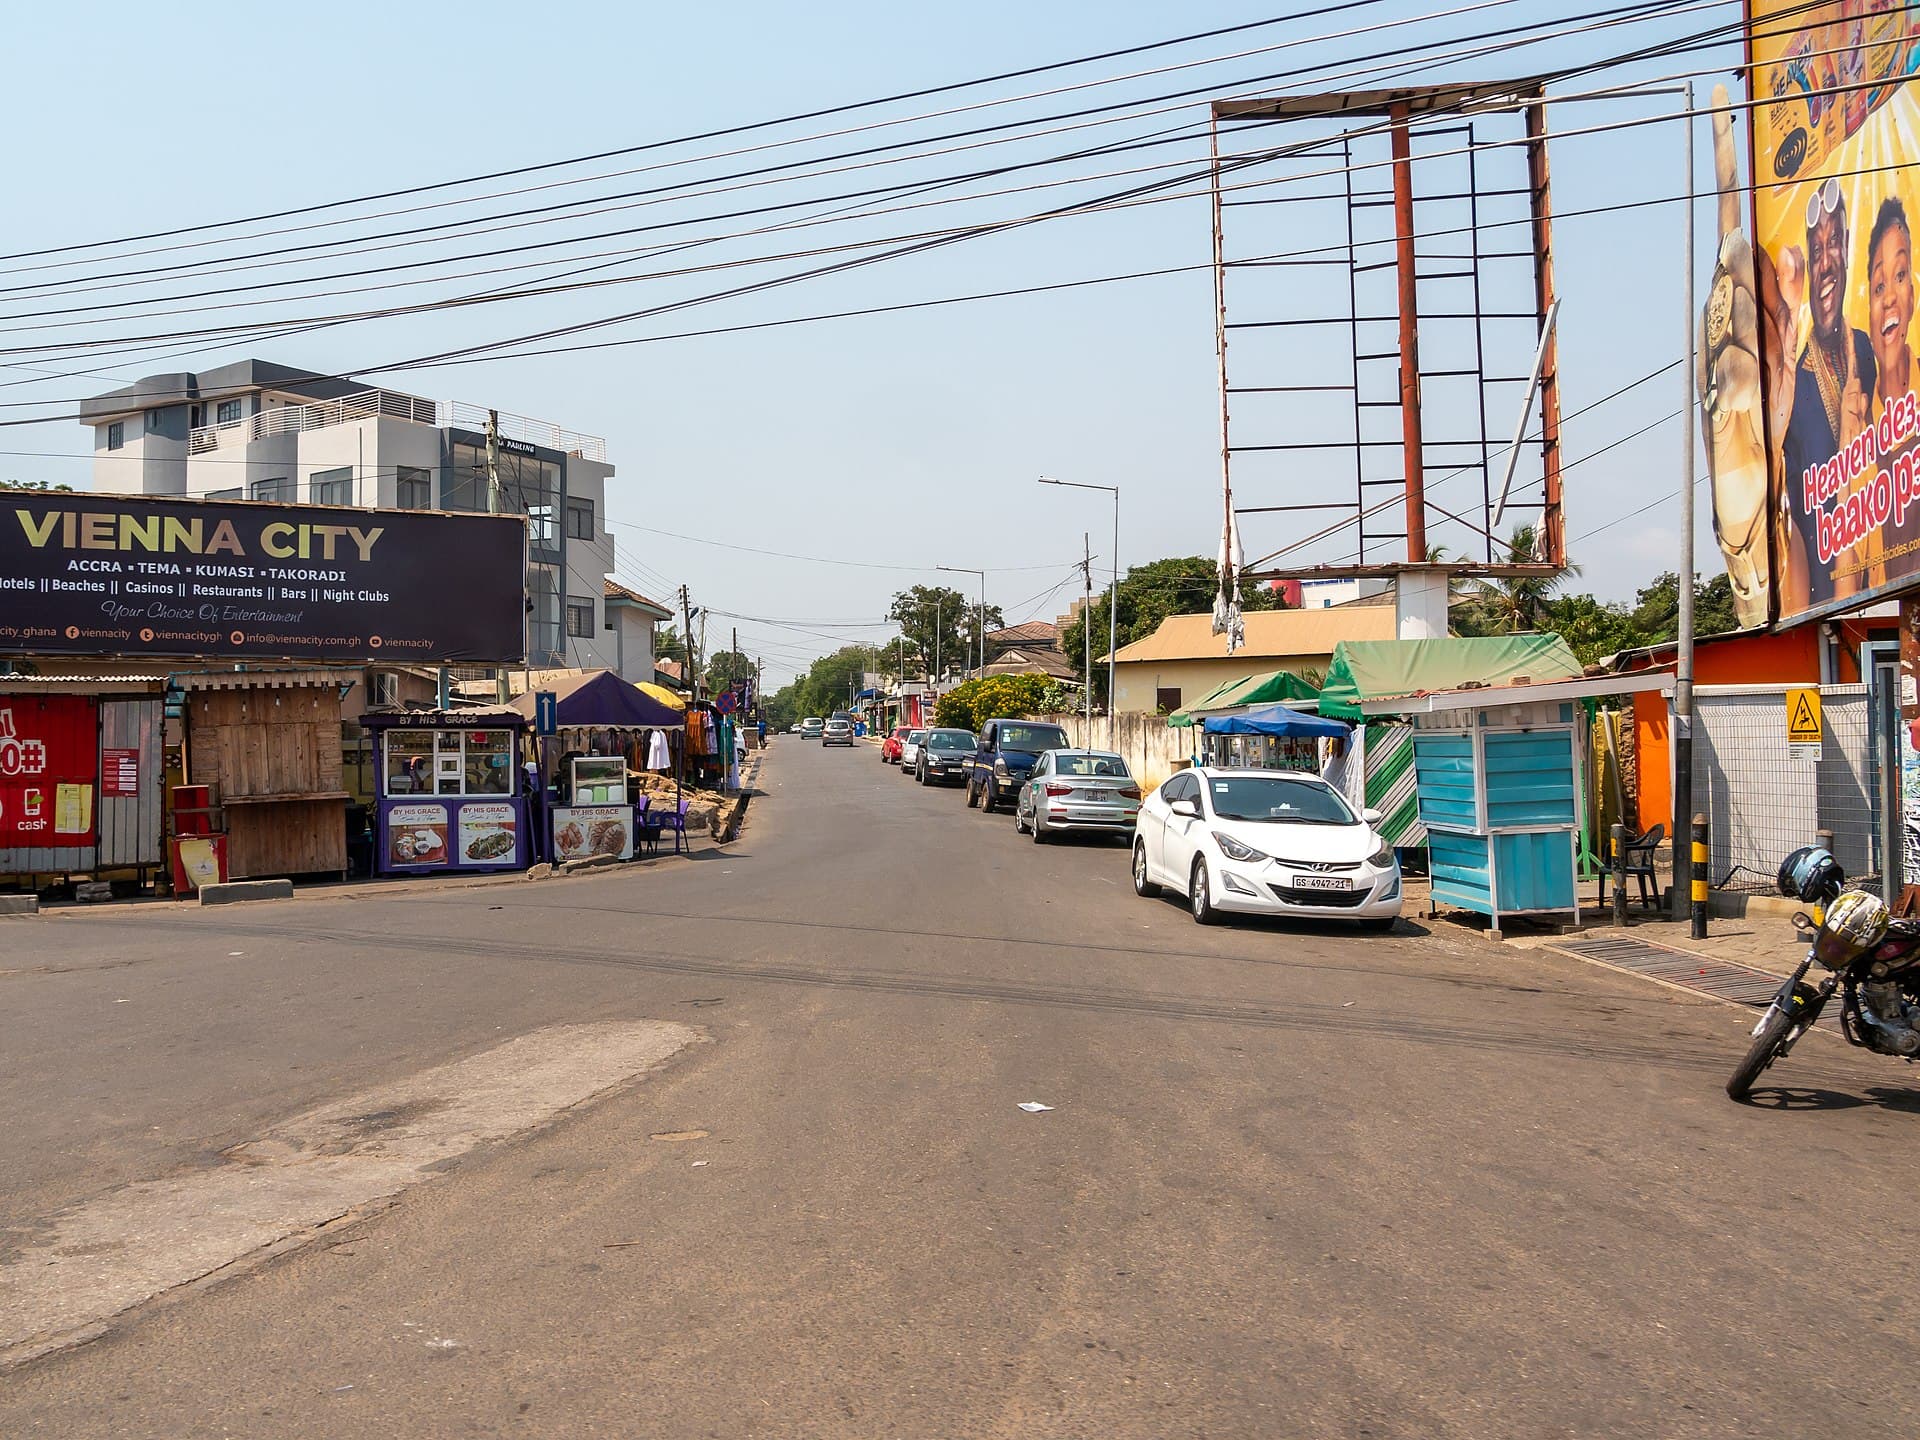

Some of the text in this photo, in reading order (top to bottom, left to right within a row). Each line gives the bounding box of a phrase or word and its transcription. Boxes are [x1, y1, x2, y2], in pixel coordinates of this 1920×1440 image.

[1803, 423, 1876, 514] Heaven
[1815, 468, 1892, 565] baako
[15, 509, 385, 562] VIENNA CITY
[67, 559, 347, 582] ACCRA TEMA KUMASI TAKORADI
[52, 578, 106, 592] Beaches
[125, 581, 174, 595] Casinos
[193, 584, 263, 598] Restaurants
[281, 587, 307, 600] Bars
[323, 588, 355, 603] Night
[358, 590, 390, 602] Clubs
[100, 600, 304, 623] Your Choice Of Entertainment
[81, 627, 132, 640] viennacity
[156, 629, 223, 643] viennacitygh
[246, 631, 361, 647] info@viennacity.com.gh
[384, 636, 434, 649] viennacity
[399, 715, 479, 725] BY HIS GRACE
[0, 739, 46, 775] 0#
[17, 818, 48, 830] cash
[1296, 878, 1345, 889] GS 4947-21
